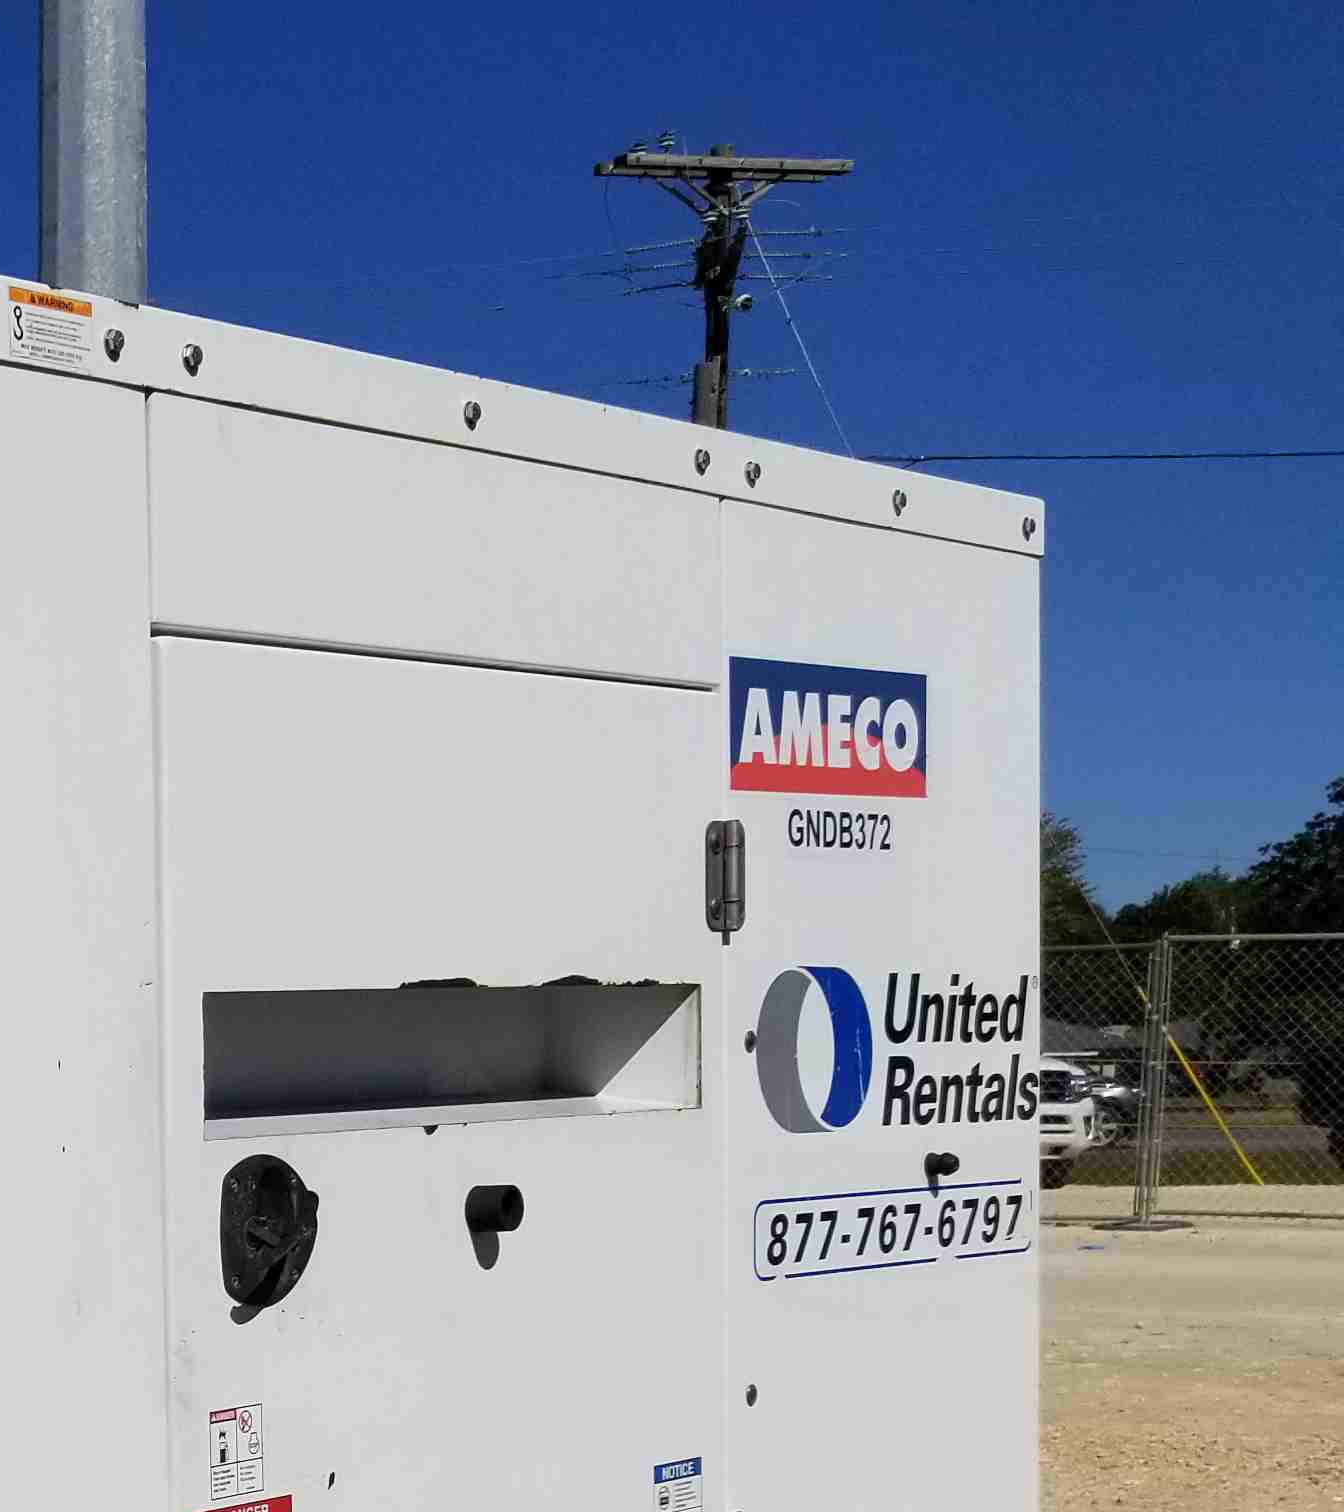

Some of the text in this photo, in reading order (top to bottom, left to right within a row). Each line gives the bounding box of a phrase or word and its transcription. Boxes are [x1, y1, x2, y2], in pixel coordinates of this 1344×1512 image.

[739, 687, 919, 773] AMECO
[788, 809, 891, 851] GNDB372
[884, 972, 1029, 1045] United
[882, 1054, 1039, 1126] Rentals
[767, 1194, 1023, 1267] 877-767-6797
